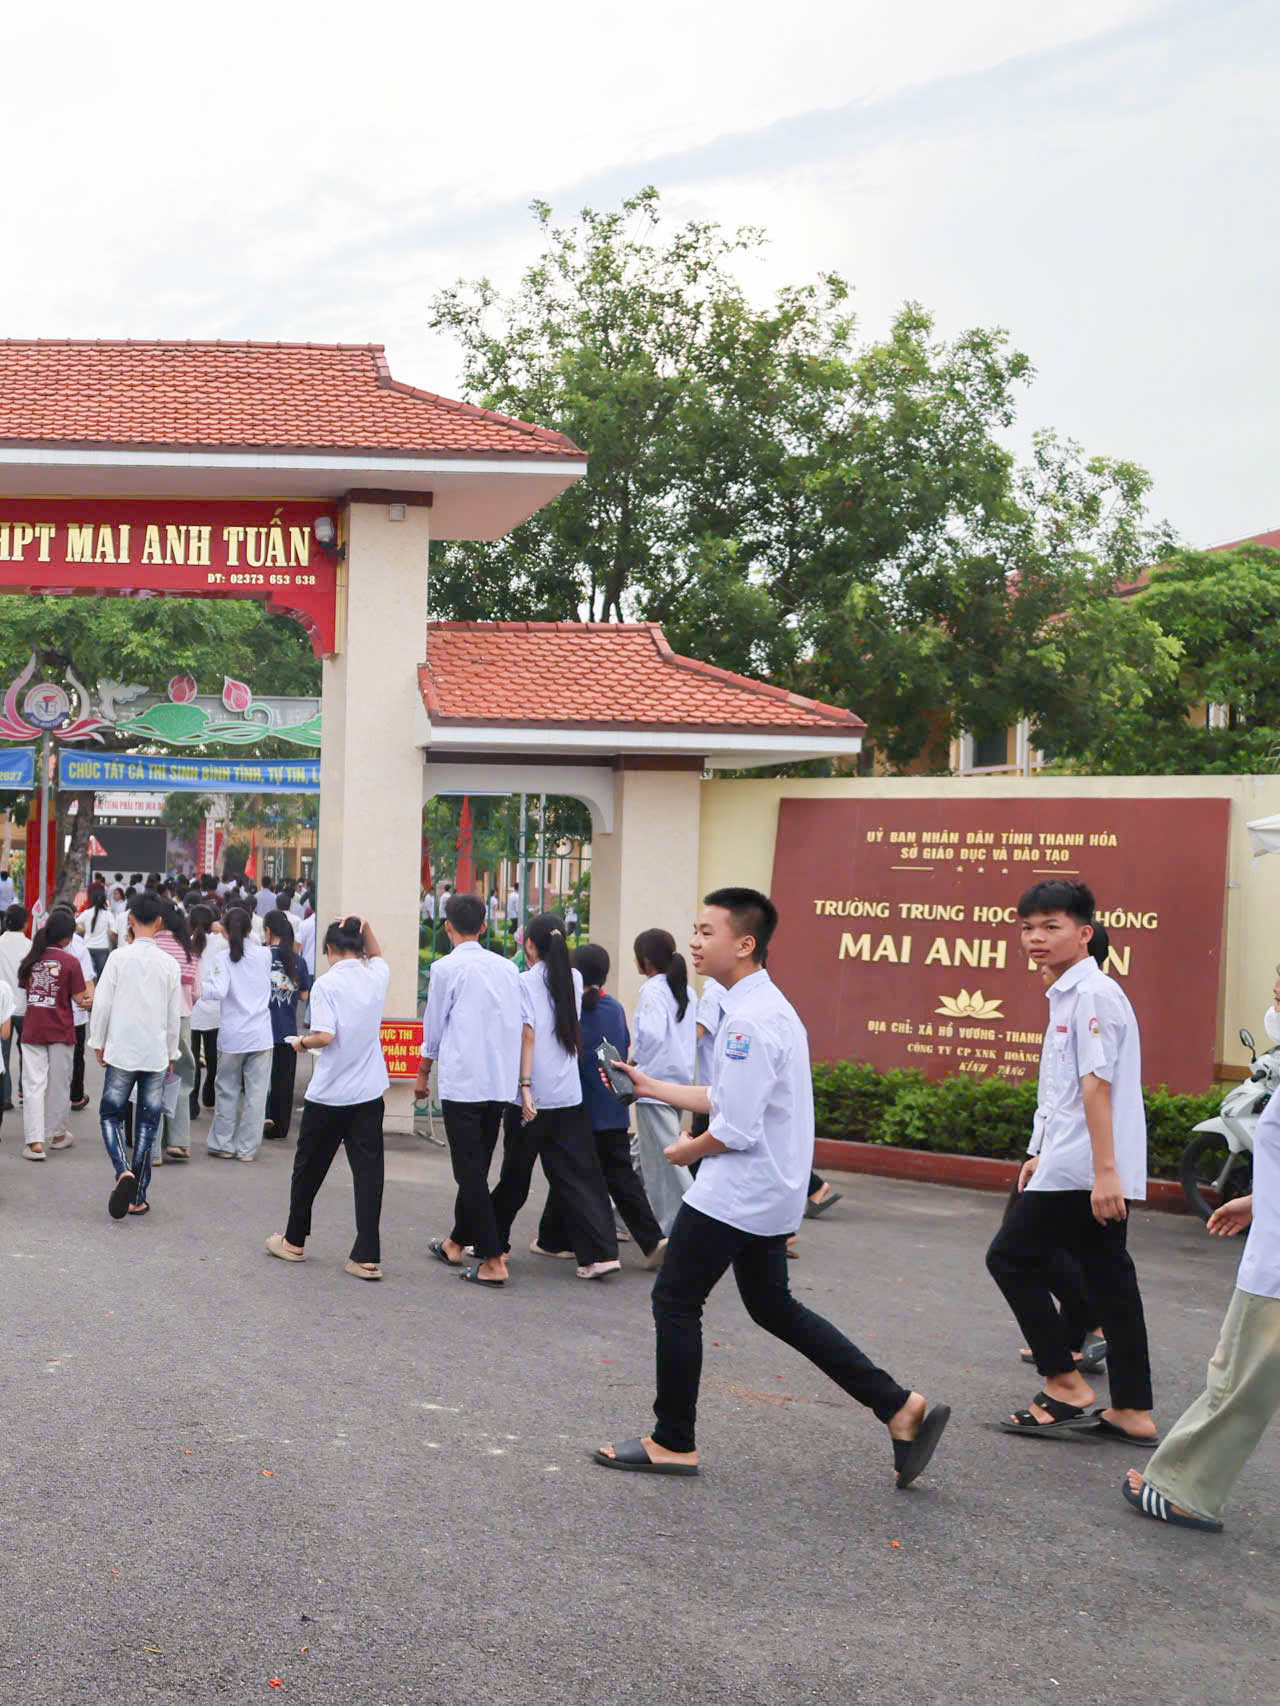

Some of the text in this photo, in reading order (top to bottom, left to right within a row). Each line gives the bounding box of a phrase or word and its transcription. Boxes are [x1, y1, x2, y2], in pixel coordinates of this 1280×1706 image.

[65, 523, 131, 563] MAI
[141, 524, 212, 565] ANH
[223, 506, 311, 567] TUẤN
[230, 574, 264, 585] 02373
[68, 758, 100, 779] CHÚC
[104, 758, 125, 779] TẤT
[128, 760, 145, 780] CẢ
[170, 764, 198, 781] SINH
[890, 831, 916, 843] BAN
[922, 829, 960, 844] NHÂN
[1001, 829, 1033, 845] TỈNH
[1039, 833, 1084, 846] THANH
[1089, 830, 1118, 847] HÓA
[923, 846, 954, 860] GIÁO
[960, 848, 987, 863] DỤC
[992, 847, 1008, 861] VÀ
[1013, 847, 1040, 862] ĐÀO
[1045, 849, 1070, 865] TẠO
[814, 896, 1158, 929] TRƯỜNG TRUNG HỌC HÔNG
[838, 932, 912, 964] MAI
[924, 937, 1007, 969] ANH
[399, 1029, 413, 1040] THI
[867, 1020, 887, 1034] ĐỊA
[891, 1019, 913, 1034] CHỈ:
[959, 1026, 996, 1041] VƯƠNG
[1006, 1031, 1043, 1045] THANH
[907, 1041, 1040, 1063] CÔNG TY CP XNK HOÀNG
[388, 1058, 407, 1072] VÀO
[959, 1060, 988, 1073] KÍNH
